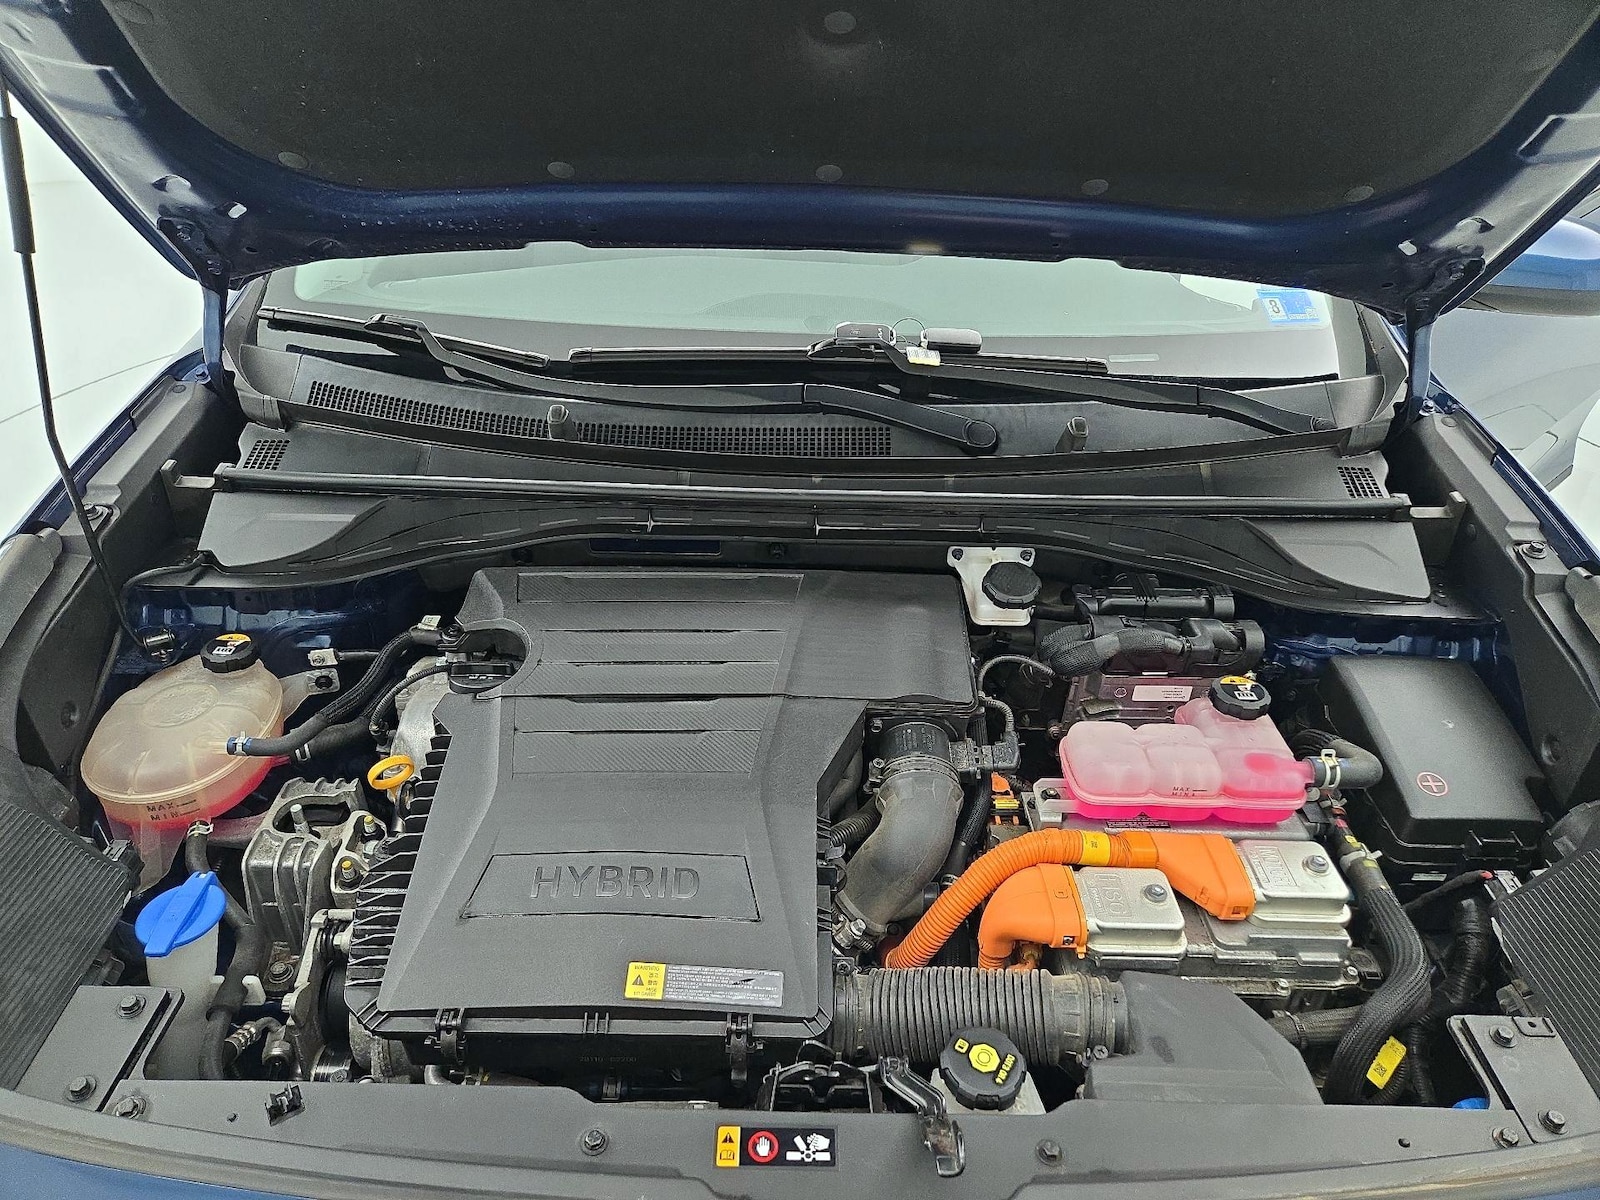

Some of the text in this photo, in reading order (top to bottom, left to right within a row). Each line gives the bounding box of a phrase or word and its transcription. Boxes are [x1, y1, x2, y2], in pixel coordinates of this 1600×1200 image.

[1268, 299, 1280, 314] 8
[146, 802, 174, 812] MAX
[150, 811, 179, 821] MIN
[529, 865, 700, 899] HYBRID
